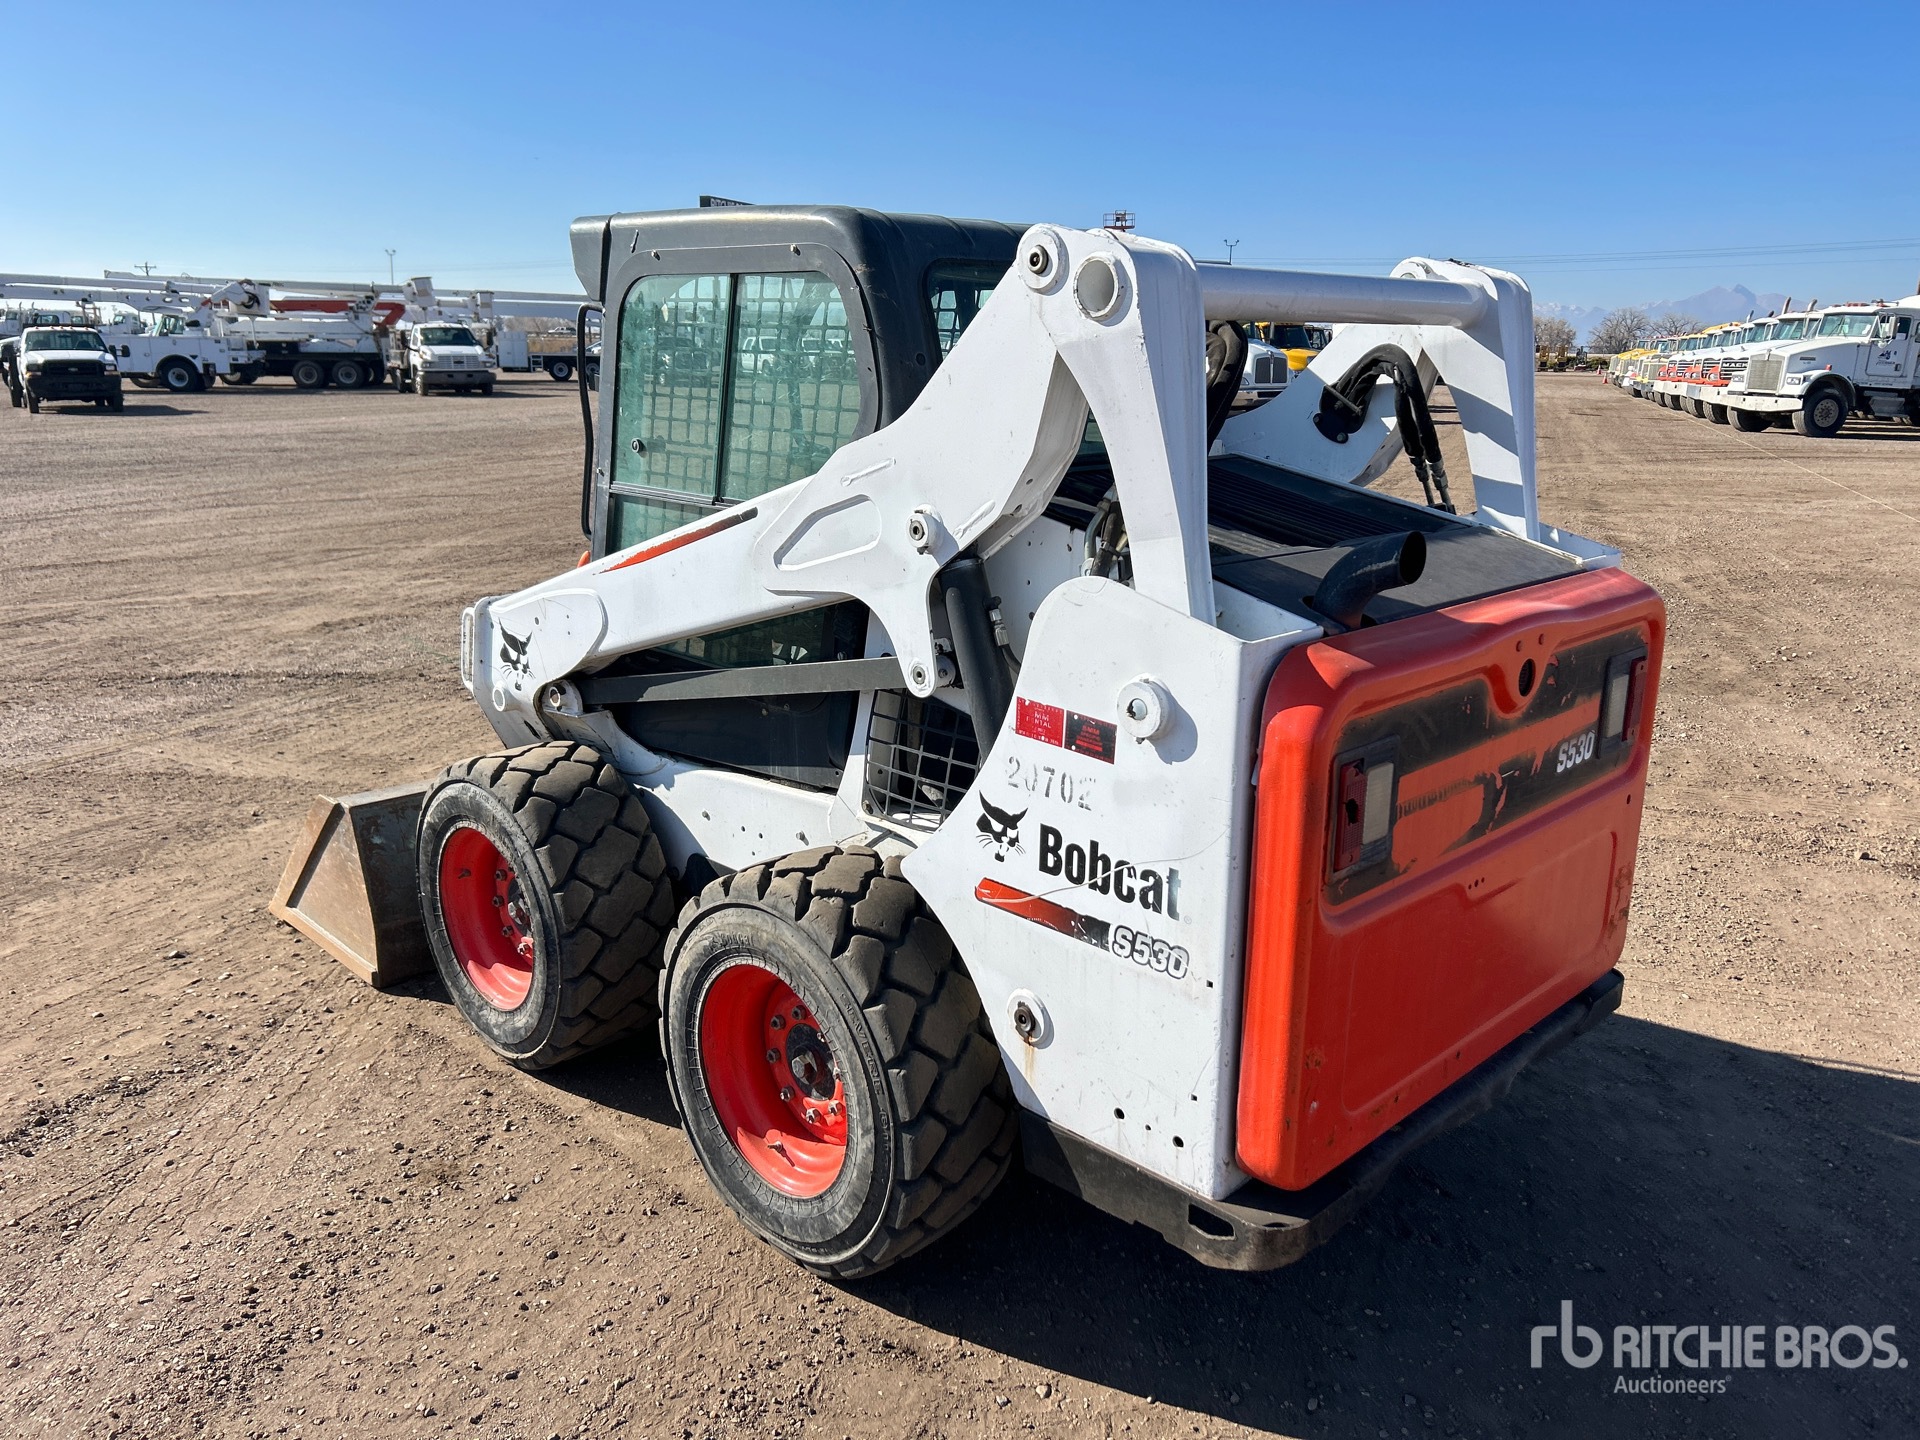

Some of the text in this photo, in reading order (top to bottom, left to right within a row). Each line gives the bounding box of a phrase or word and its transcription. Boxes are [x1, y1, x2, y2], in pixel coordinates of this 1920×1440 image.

[1556, 730, 1595, 773] S530
[1039, 823, 1182, 922] Bobcat
[1111, 924, 1190, 980] S530
